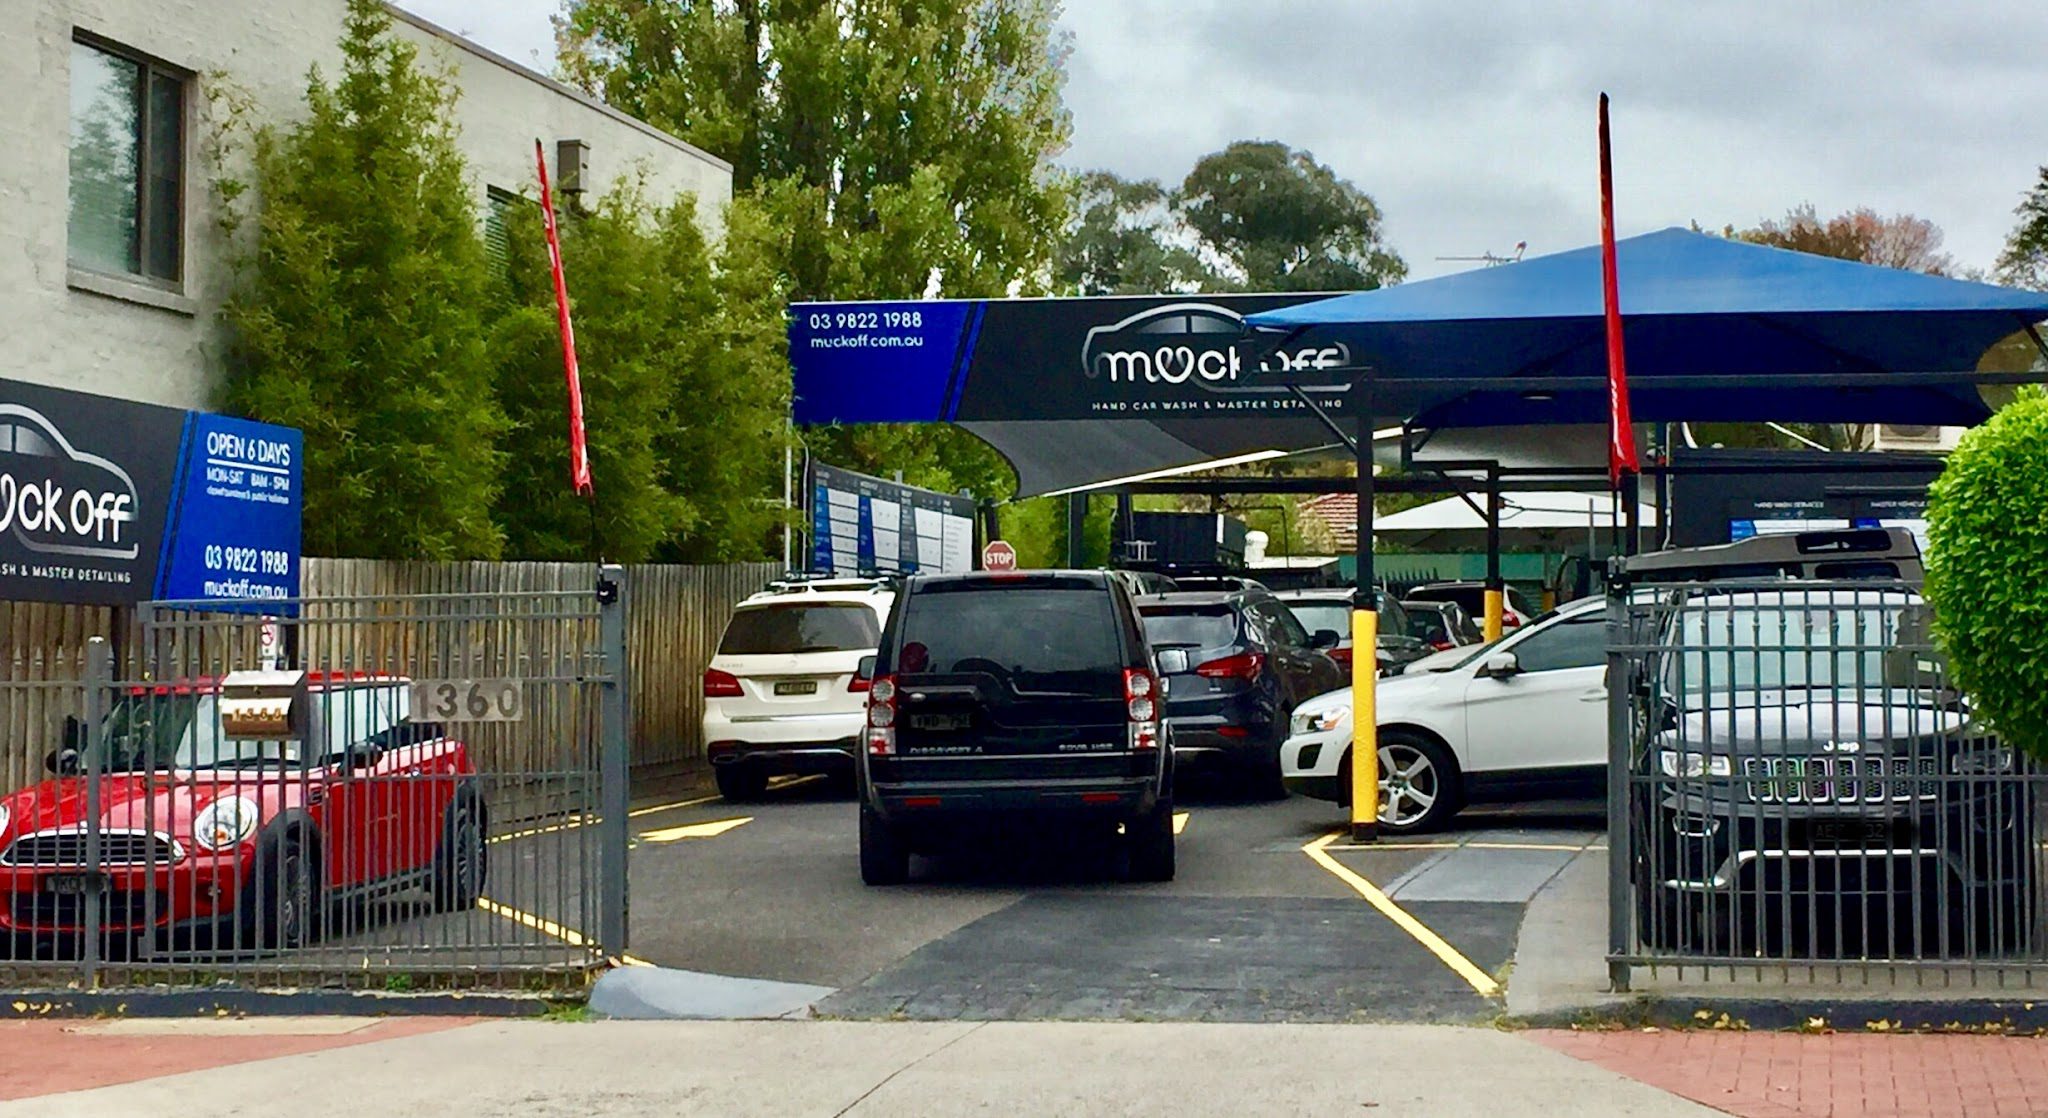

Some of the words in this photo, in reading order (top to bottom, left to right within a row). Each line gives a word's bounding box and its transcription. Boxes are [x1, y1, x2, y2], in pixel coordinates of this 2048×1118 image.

[810, 313, 832, 330] 03
[836, 312, 878, 329] 9822
[883, 311, 922, 328] 1988
[810, 334, 923, 348] muckoff.com.au
[1092, 402, 1127, 411] HAND
[1133, 402, 1157, 410] CAR
[1162, 402, 1197, 410] WASH
[1217, 401, 1267, 409] MASTER
[1273, 400, 1342, 409] DETAING
[207, 431, 245, 459] OPEN
[247, 439, 256, 461] 6
[258, 439, 291, 467] DAYS
[206, 466, 245, 485] MON-SAT
[205, 544, 222, 570] 03
[225, 546, 257, 573] 9822
[260, 549, 288, 575] 1988
[986, 552, 1012, 565] STOP
[32, 566, 74, 579] MASTER
[78, 568, 131, 584] DETAILING
[204, 578, 288, 600] muckoff.com.au
[414, 683, 519, 718] 1360
